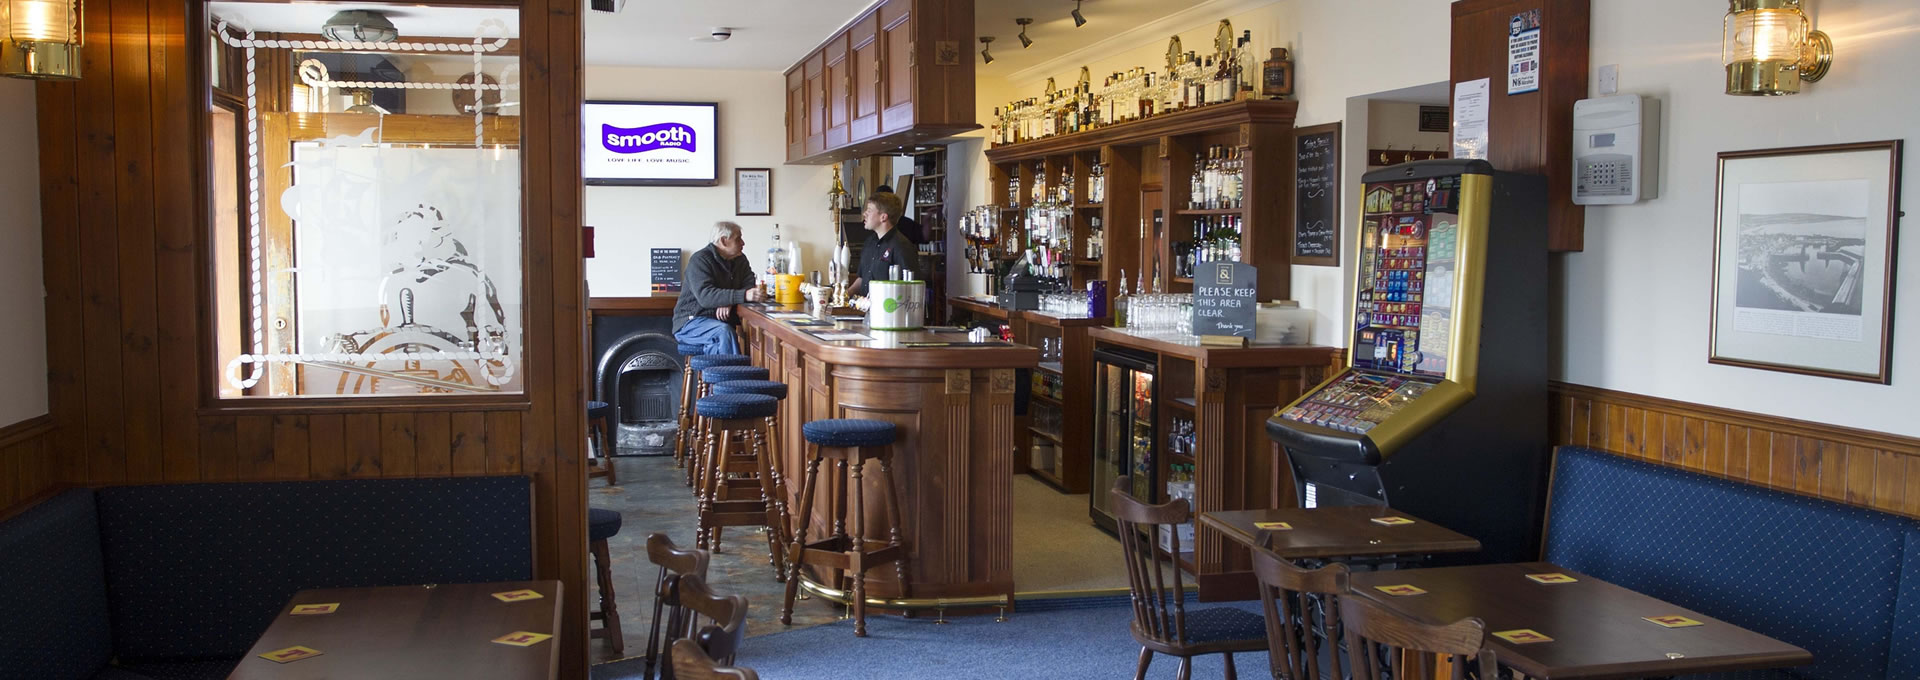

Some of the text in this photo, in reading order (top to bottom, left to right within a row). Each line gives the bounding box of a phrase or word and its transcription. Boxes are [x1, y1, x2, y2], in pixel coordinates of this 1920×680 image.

[607, 126, 692, 147] smooth
[1198, 286, 1256, 298] PLEASE KEEP
[1197, 298, 1242, 308] THIS AREA
[1216, 321, 1233, 330] Thank
